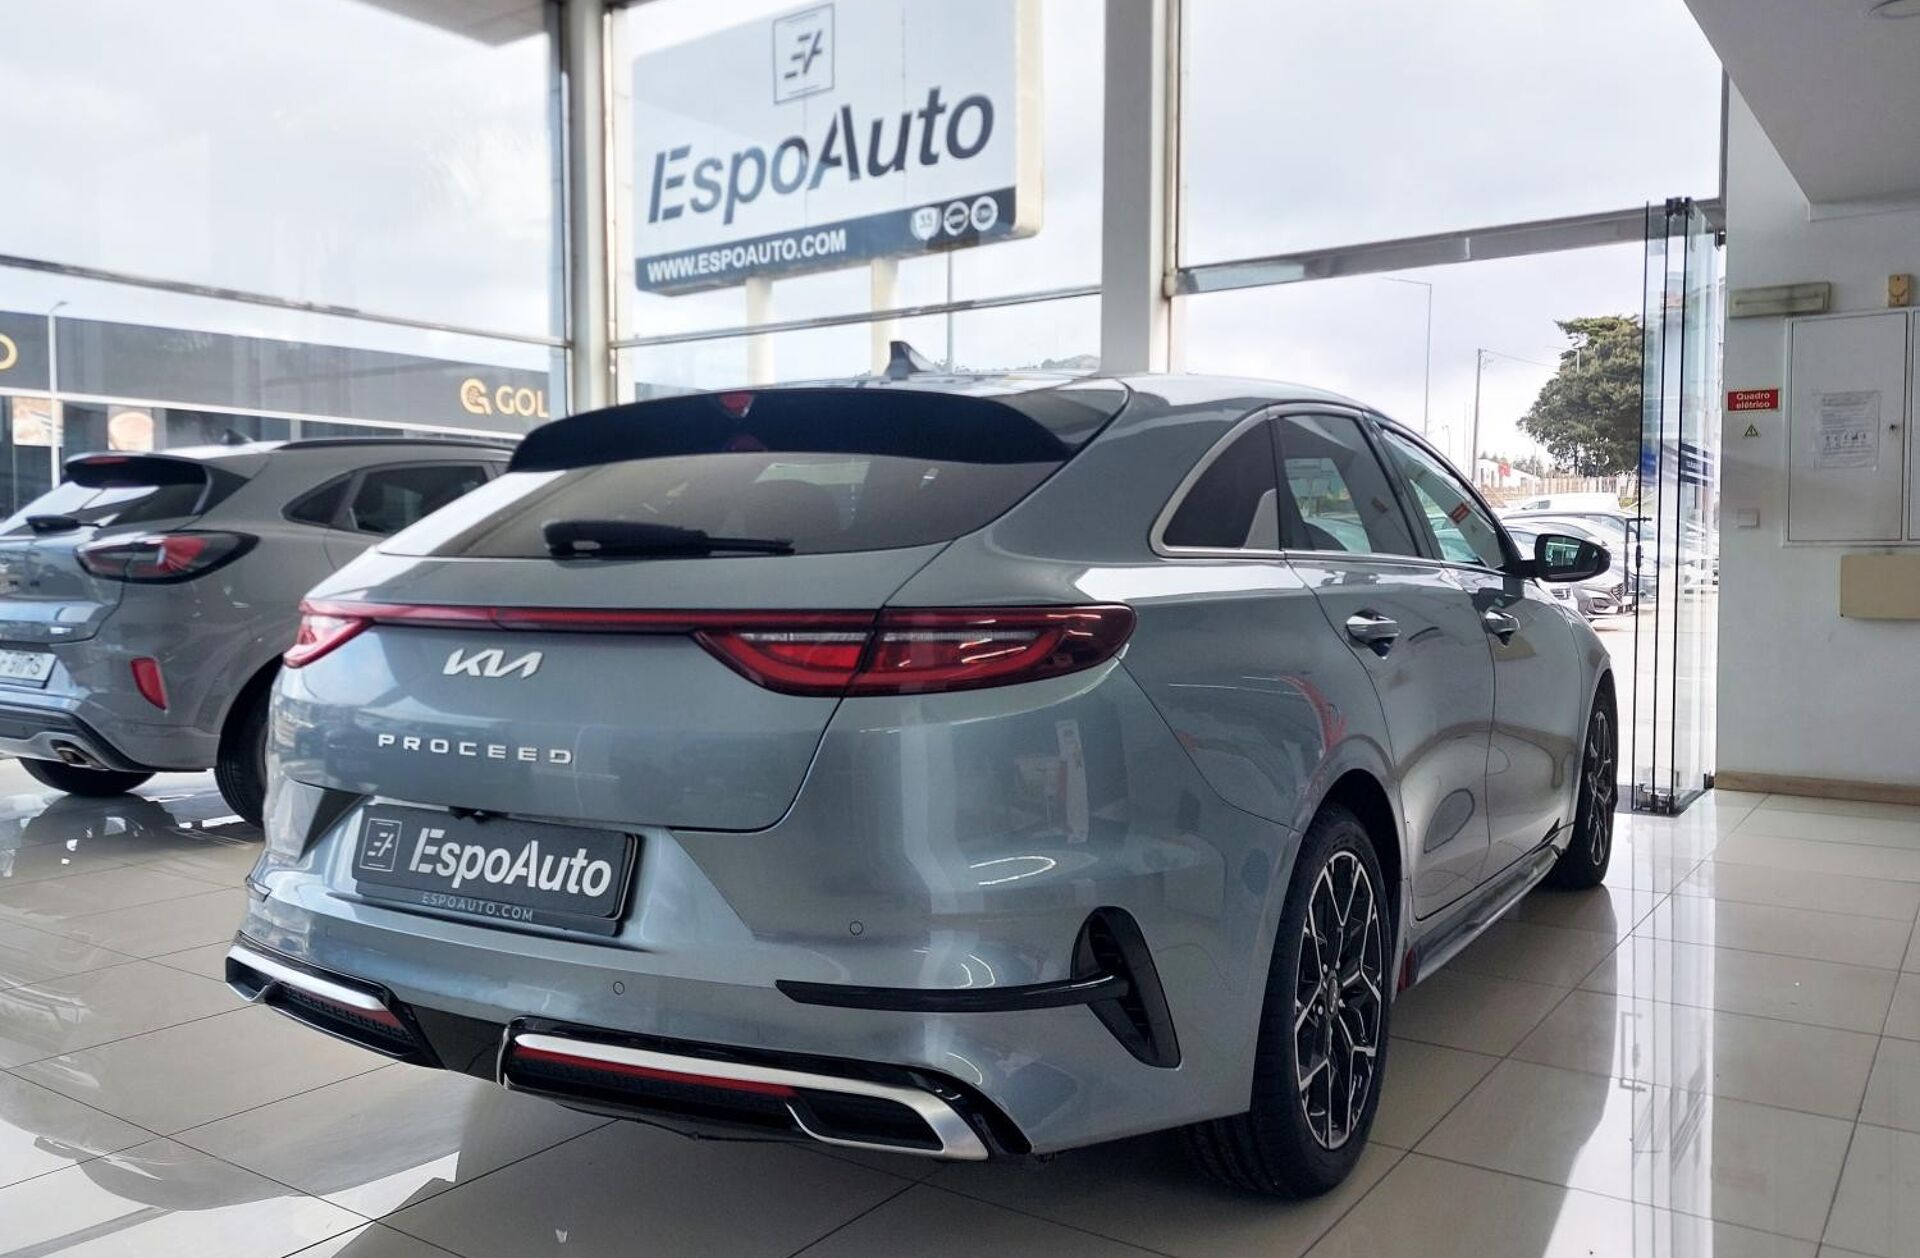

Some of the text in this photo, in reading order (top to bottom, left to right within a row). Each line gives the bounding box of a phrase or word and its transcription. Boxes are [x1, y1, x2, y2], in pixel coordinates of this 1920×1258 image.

[648, 86, 995, 226] EspoAuto
[647, 229, 846, 283] WWW.ESPOAUTO.COM
[1736, 391, 1770, 400] Quadro
[378, 733, 573, 765] PROCEED
[409, 827, 612, 898] EspoAuto
[422, 891, 534, 921] ESPOAUTO.COM
